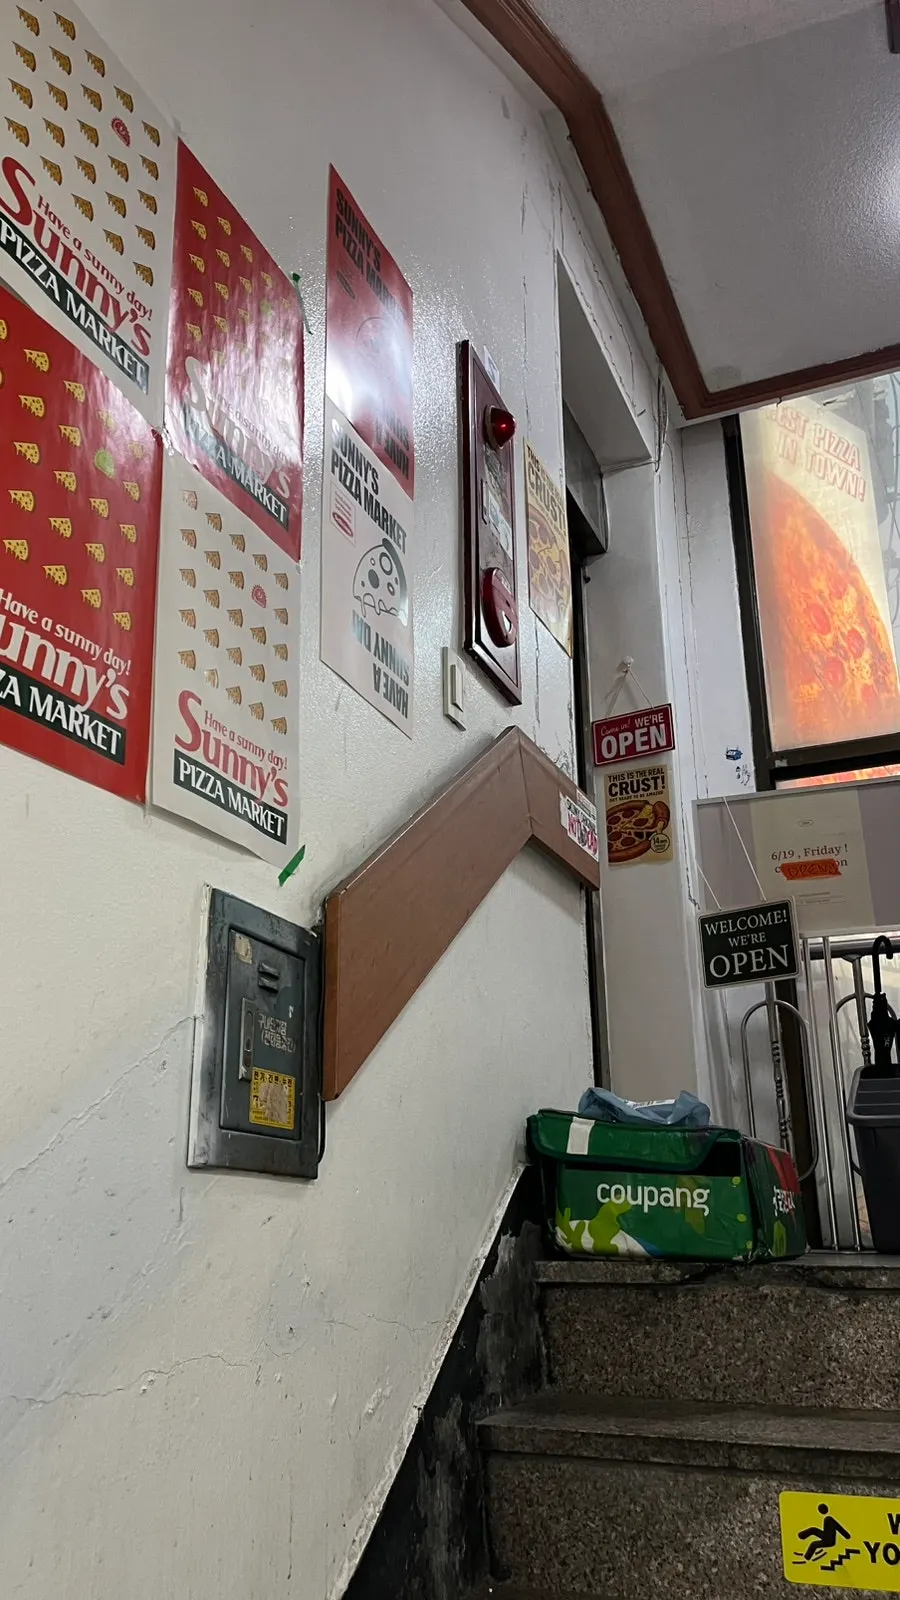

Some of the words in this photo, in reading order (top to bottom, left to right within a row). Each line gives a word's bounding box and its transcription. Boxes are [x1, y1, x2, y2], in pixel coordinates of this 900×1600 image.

[0, 156, 151, 357] Sunny's
[37, 194, 71, 239] Have
[73, 237, 82, 249] a
[84, 248, 125, 295] sunny
[127, 291, 153, 321] day!
[335, 214, 364, 275] PIZZA
[336, 188, 381, 272] SUNNY'S
[0, 217, 60, 301] PIZZA
[66, 289, 147, 388] MARKET
[332, 419, 379, 496] SUNNY'S
[814, 422, 861, 472] PIZZA
[231, 457, 287, 522] MARKET
[331, 448, 362, 506] PIZZA
[364, 486, 407, 555] MARKET
[805, 449, 867, 502] TOWN!
[0, 588, 38, 624] Have
[41, 617, 53, 632] a
[54, 623, 102, 661] sunny
[103, 648, 132, 676] day!
[373, 632, 409, 687] SUNNY
[0, 614, 130, 721] unny's
[372, 663, 381, 693] A
[29, 685, 122, 755] MARKET
[383, 672, 409, 719] HAVE
[635, 713, 664, 728] WE'RE
[175, 689, 289, 807] Sunny's
[204, 710, 228, 737] Have
[229, 731, 235, 741] a
[237, 735, 266, 762] sunny
[267, 750, 288, 771] day!
[601, 724, 666, 759] OPEN
[178, 757, 225, 804] PIZZA
[227, 787, 285, 837] MARKET
[608, 774, 625, 782] THIS
[627, 772, 634, 780] IS
[636, 770, 646, 778] THE
[648, 768, 664, 776] REAL
[609, 775, 665, 797] CRUST!
[771, 850, 794, 861] 6/19
[705, 909, 788, 936] WELCOME!
[728, 932, 766, 948] WE'RE
[709, 944, 789, 979] OPEN
[597, 1183, 710, 1216] coupang
[863, 1541, 900, 1566] YO
